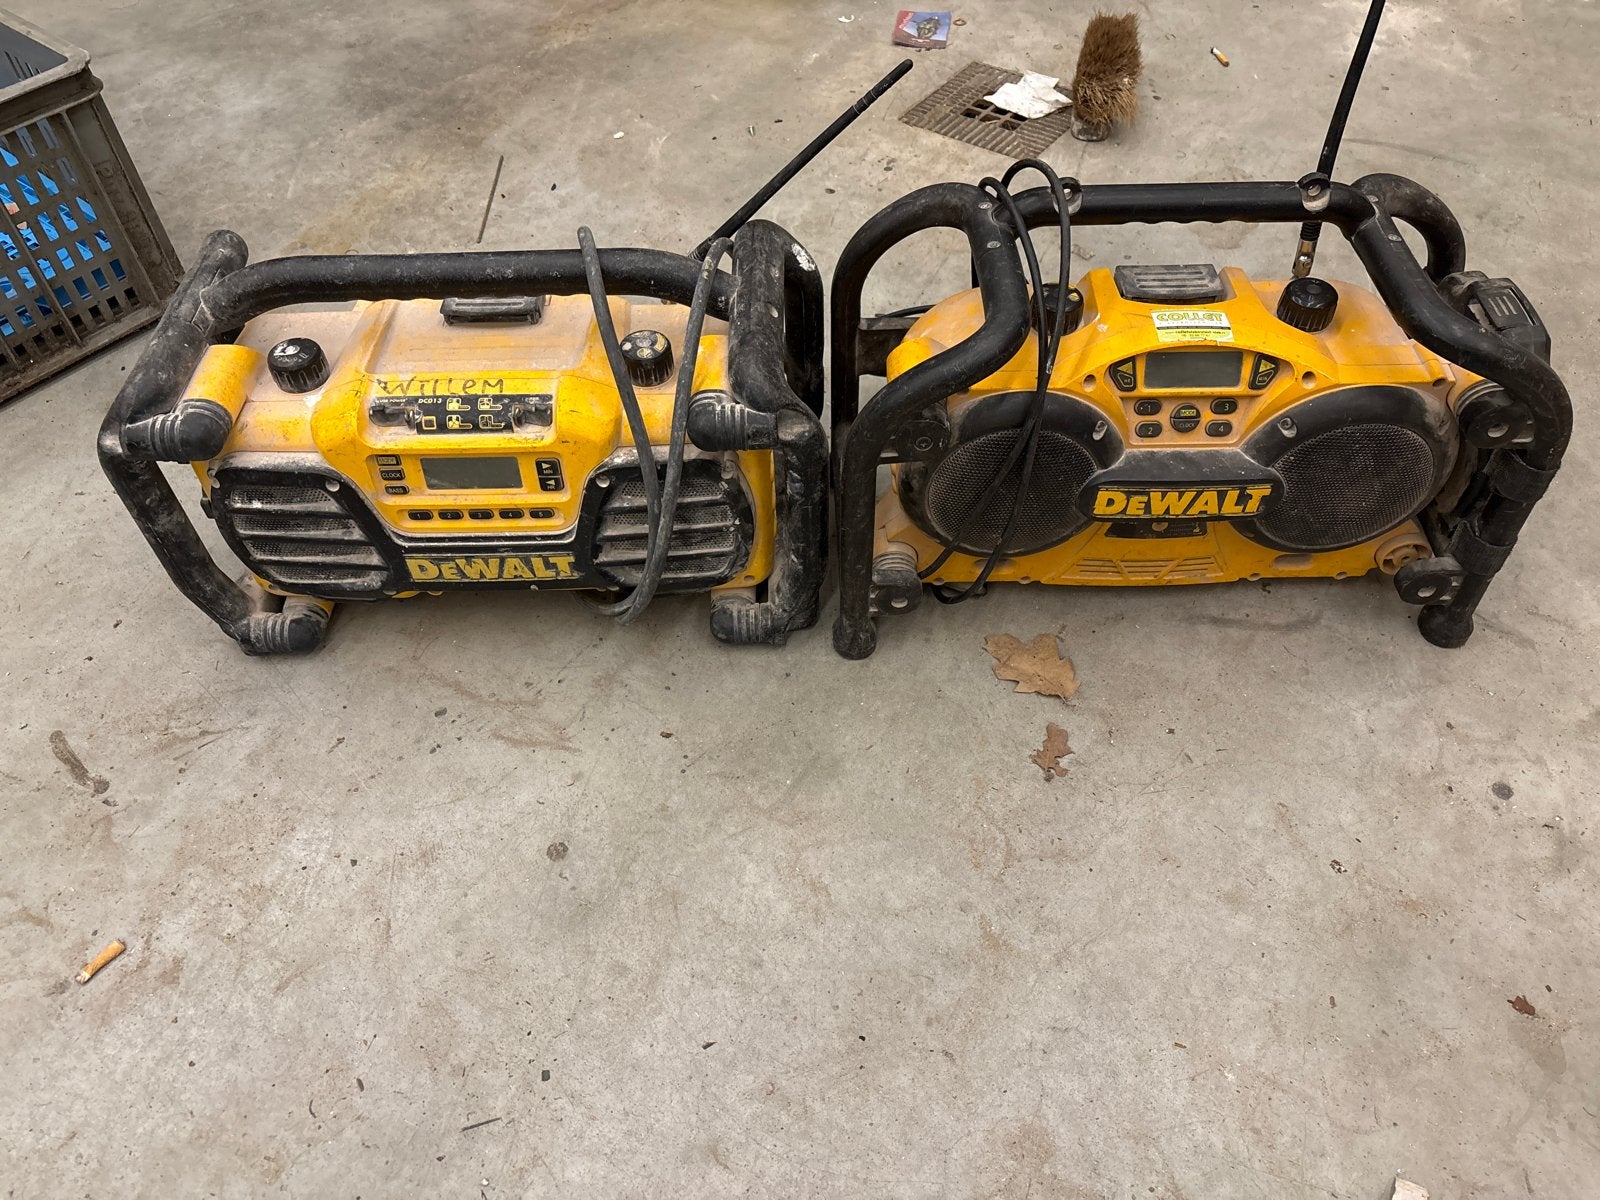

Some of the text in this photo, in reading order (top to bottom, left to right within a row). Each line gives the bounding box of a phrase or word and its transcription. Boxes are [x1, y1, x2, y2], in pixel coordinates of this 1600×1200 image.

[1156, 312, 1223, 322] COLLET
[1147, 427, 1153, 435] 2
[1093, 488, 1272, 515] DEWALT
[404, 556, 576, 580] DEWALT
